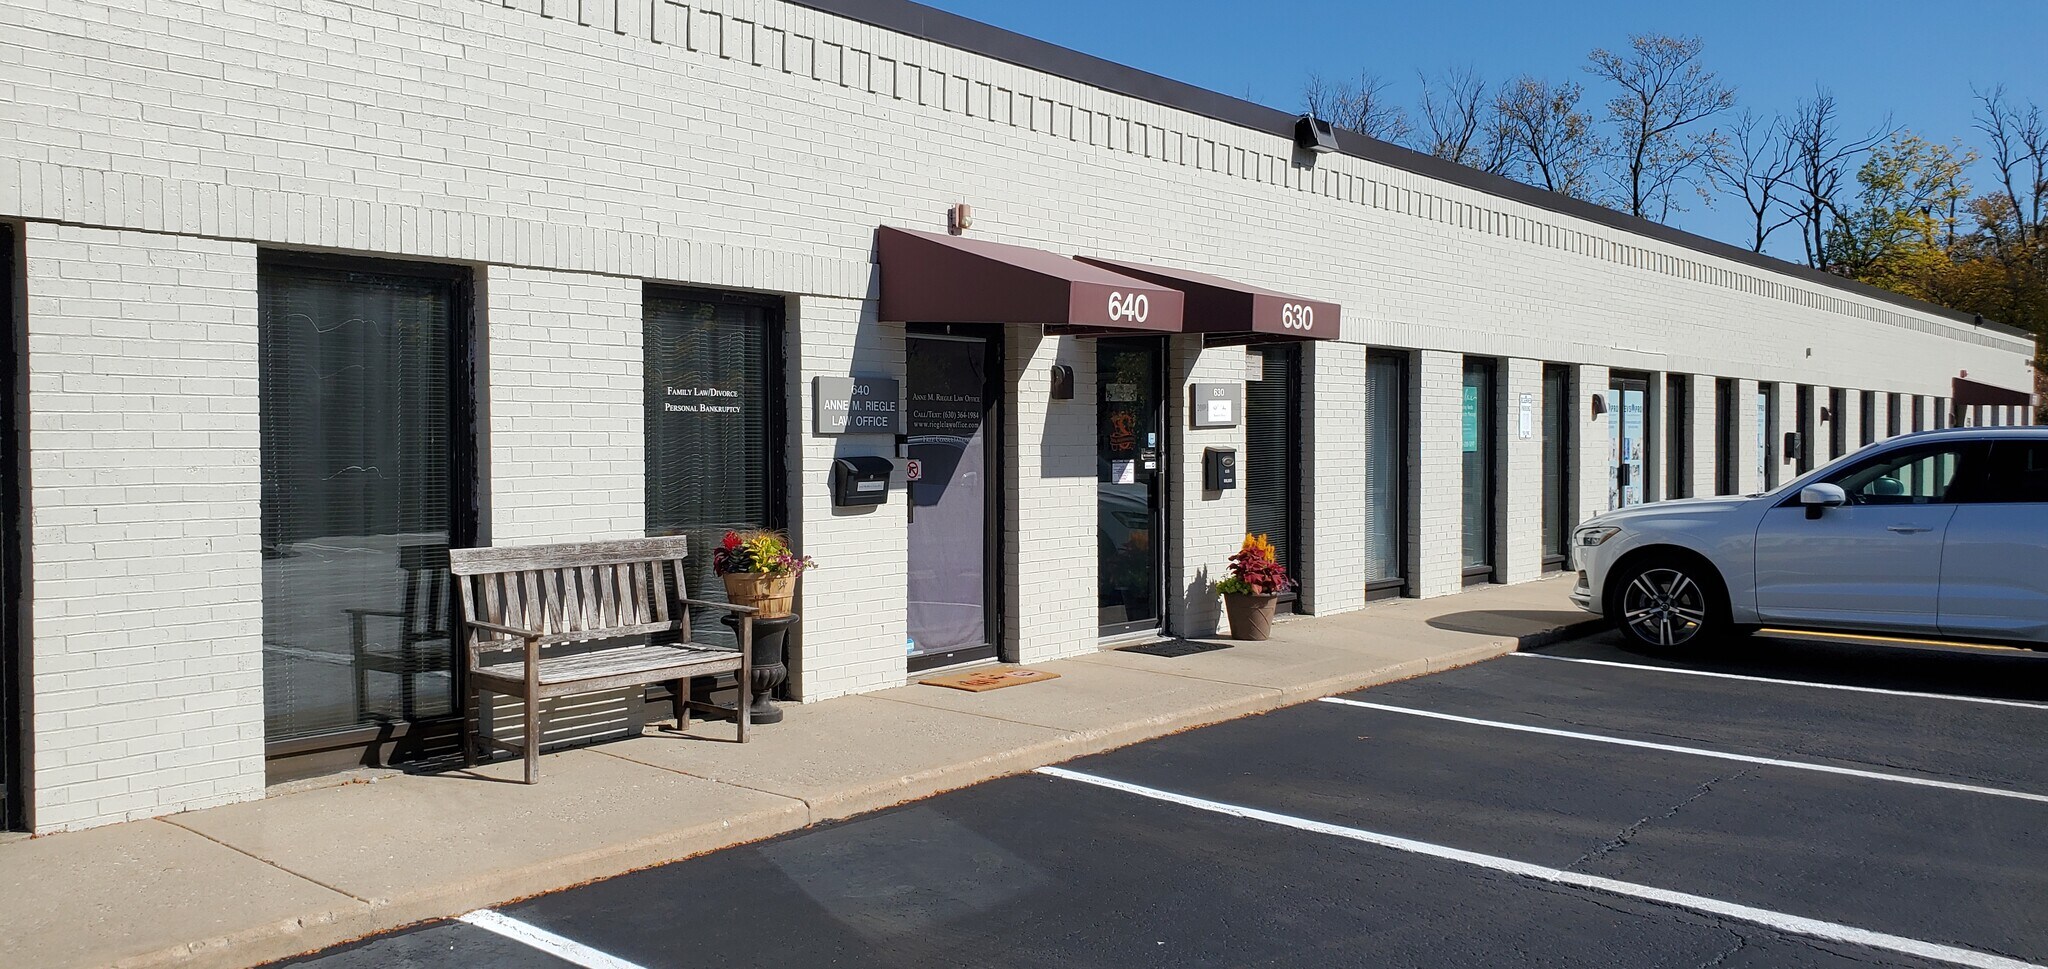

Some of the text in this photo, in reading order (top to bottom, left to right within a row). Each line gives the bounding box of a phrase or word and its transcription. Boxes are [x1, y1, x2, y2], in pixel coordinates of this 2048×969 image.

[1108, 291, 1149, 323] 640
[1282, 302, 1313, 331] 630
[667, 386, 738, 397] FAMILY LAW/DIVORCE
[851, 384, 870, 395] 640
[1213, 388, 1225, 397] 630
[664, 402, 741, 413] PERSONAL BANKRUPTCY
[824, 400, 896, 412] ANNE M. RIEGLE
[942, 410, 956, 420] (630)
[832, 415, 888, 427] LAW OFFICE
